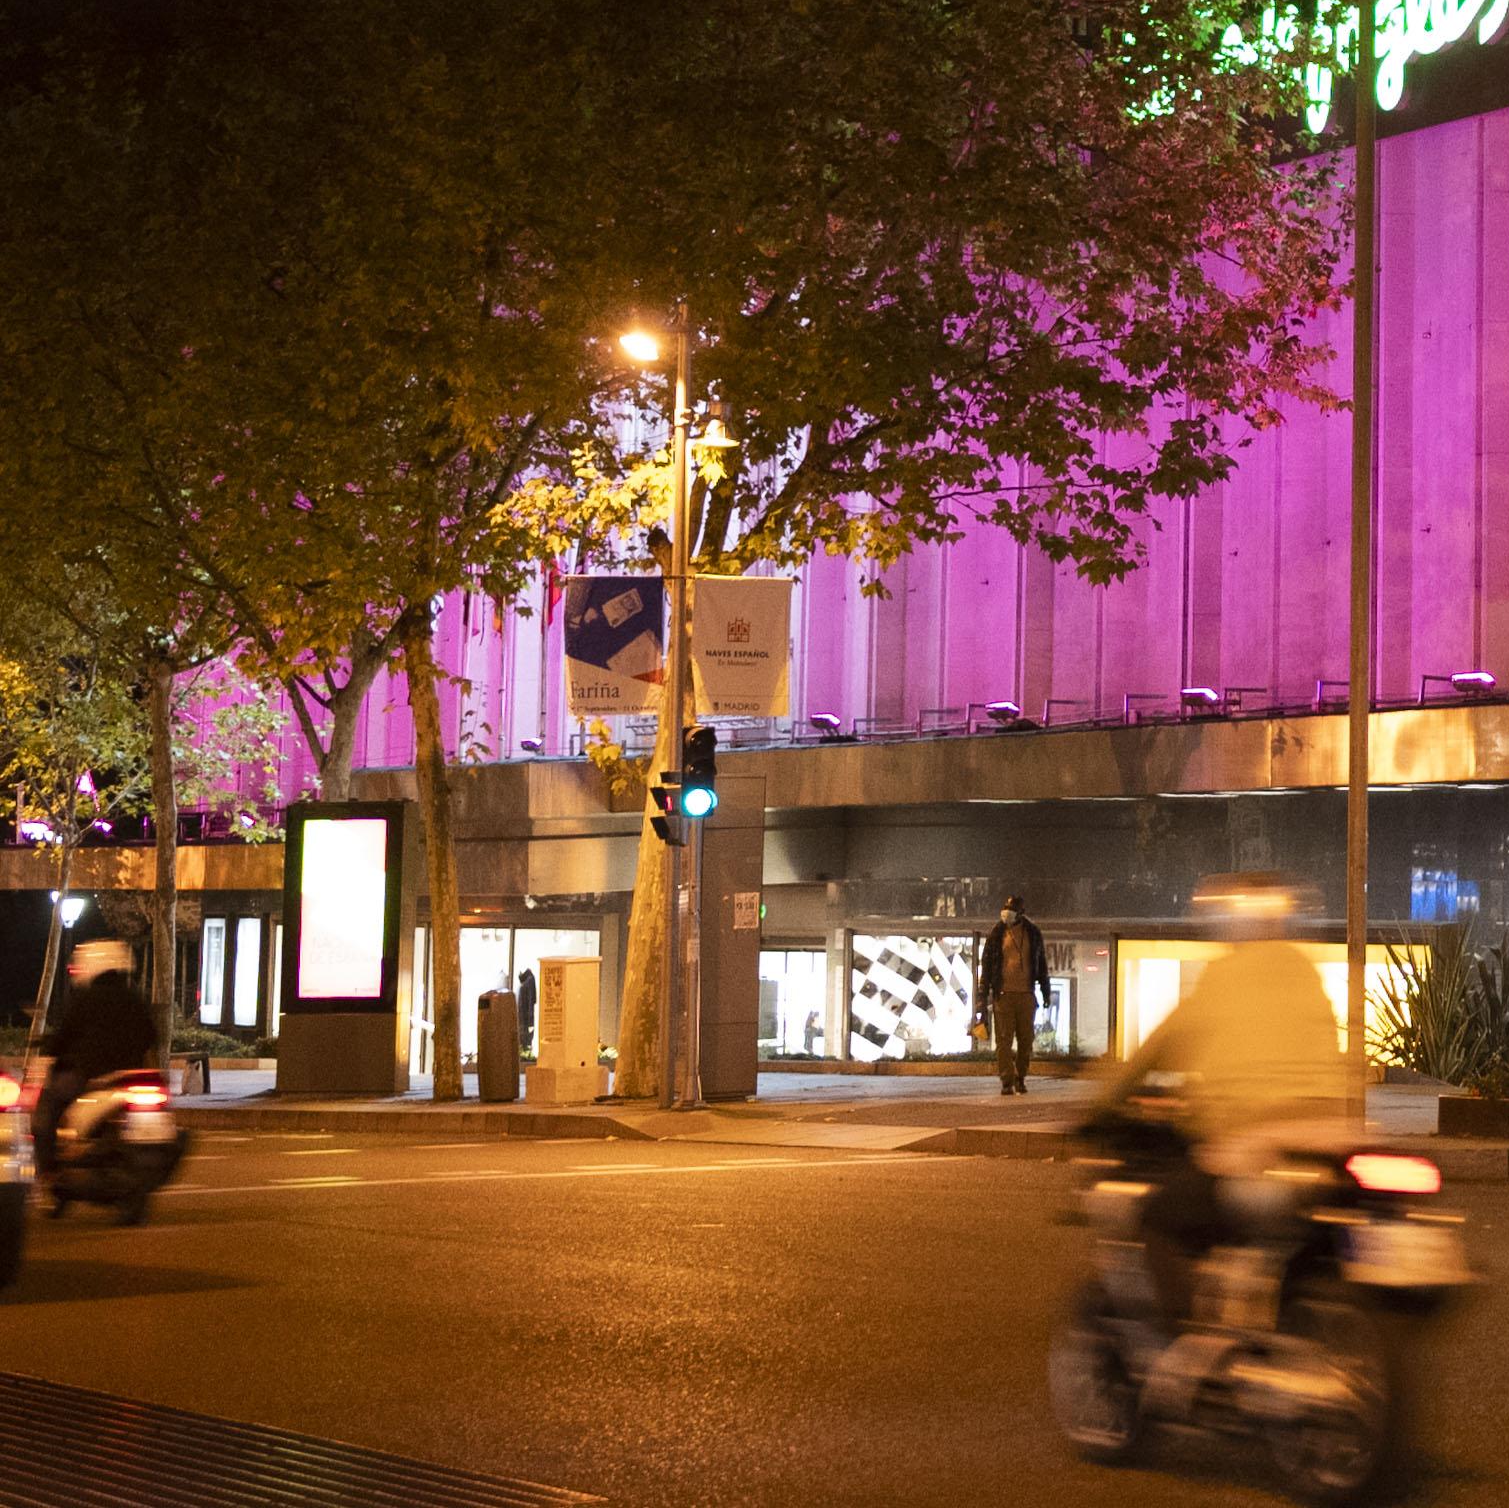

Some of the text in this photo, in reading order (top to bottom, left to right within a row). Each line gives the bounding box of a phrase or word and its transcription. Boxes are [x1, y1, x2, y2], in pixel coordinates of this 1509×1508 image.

[705, 649, 732, 658] NAVES
[571, 680, 620, 699] Fariña
[724, 702, 760, 711] MADRID
